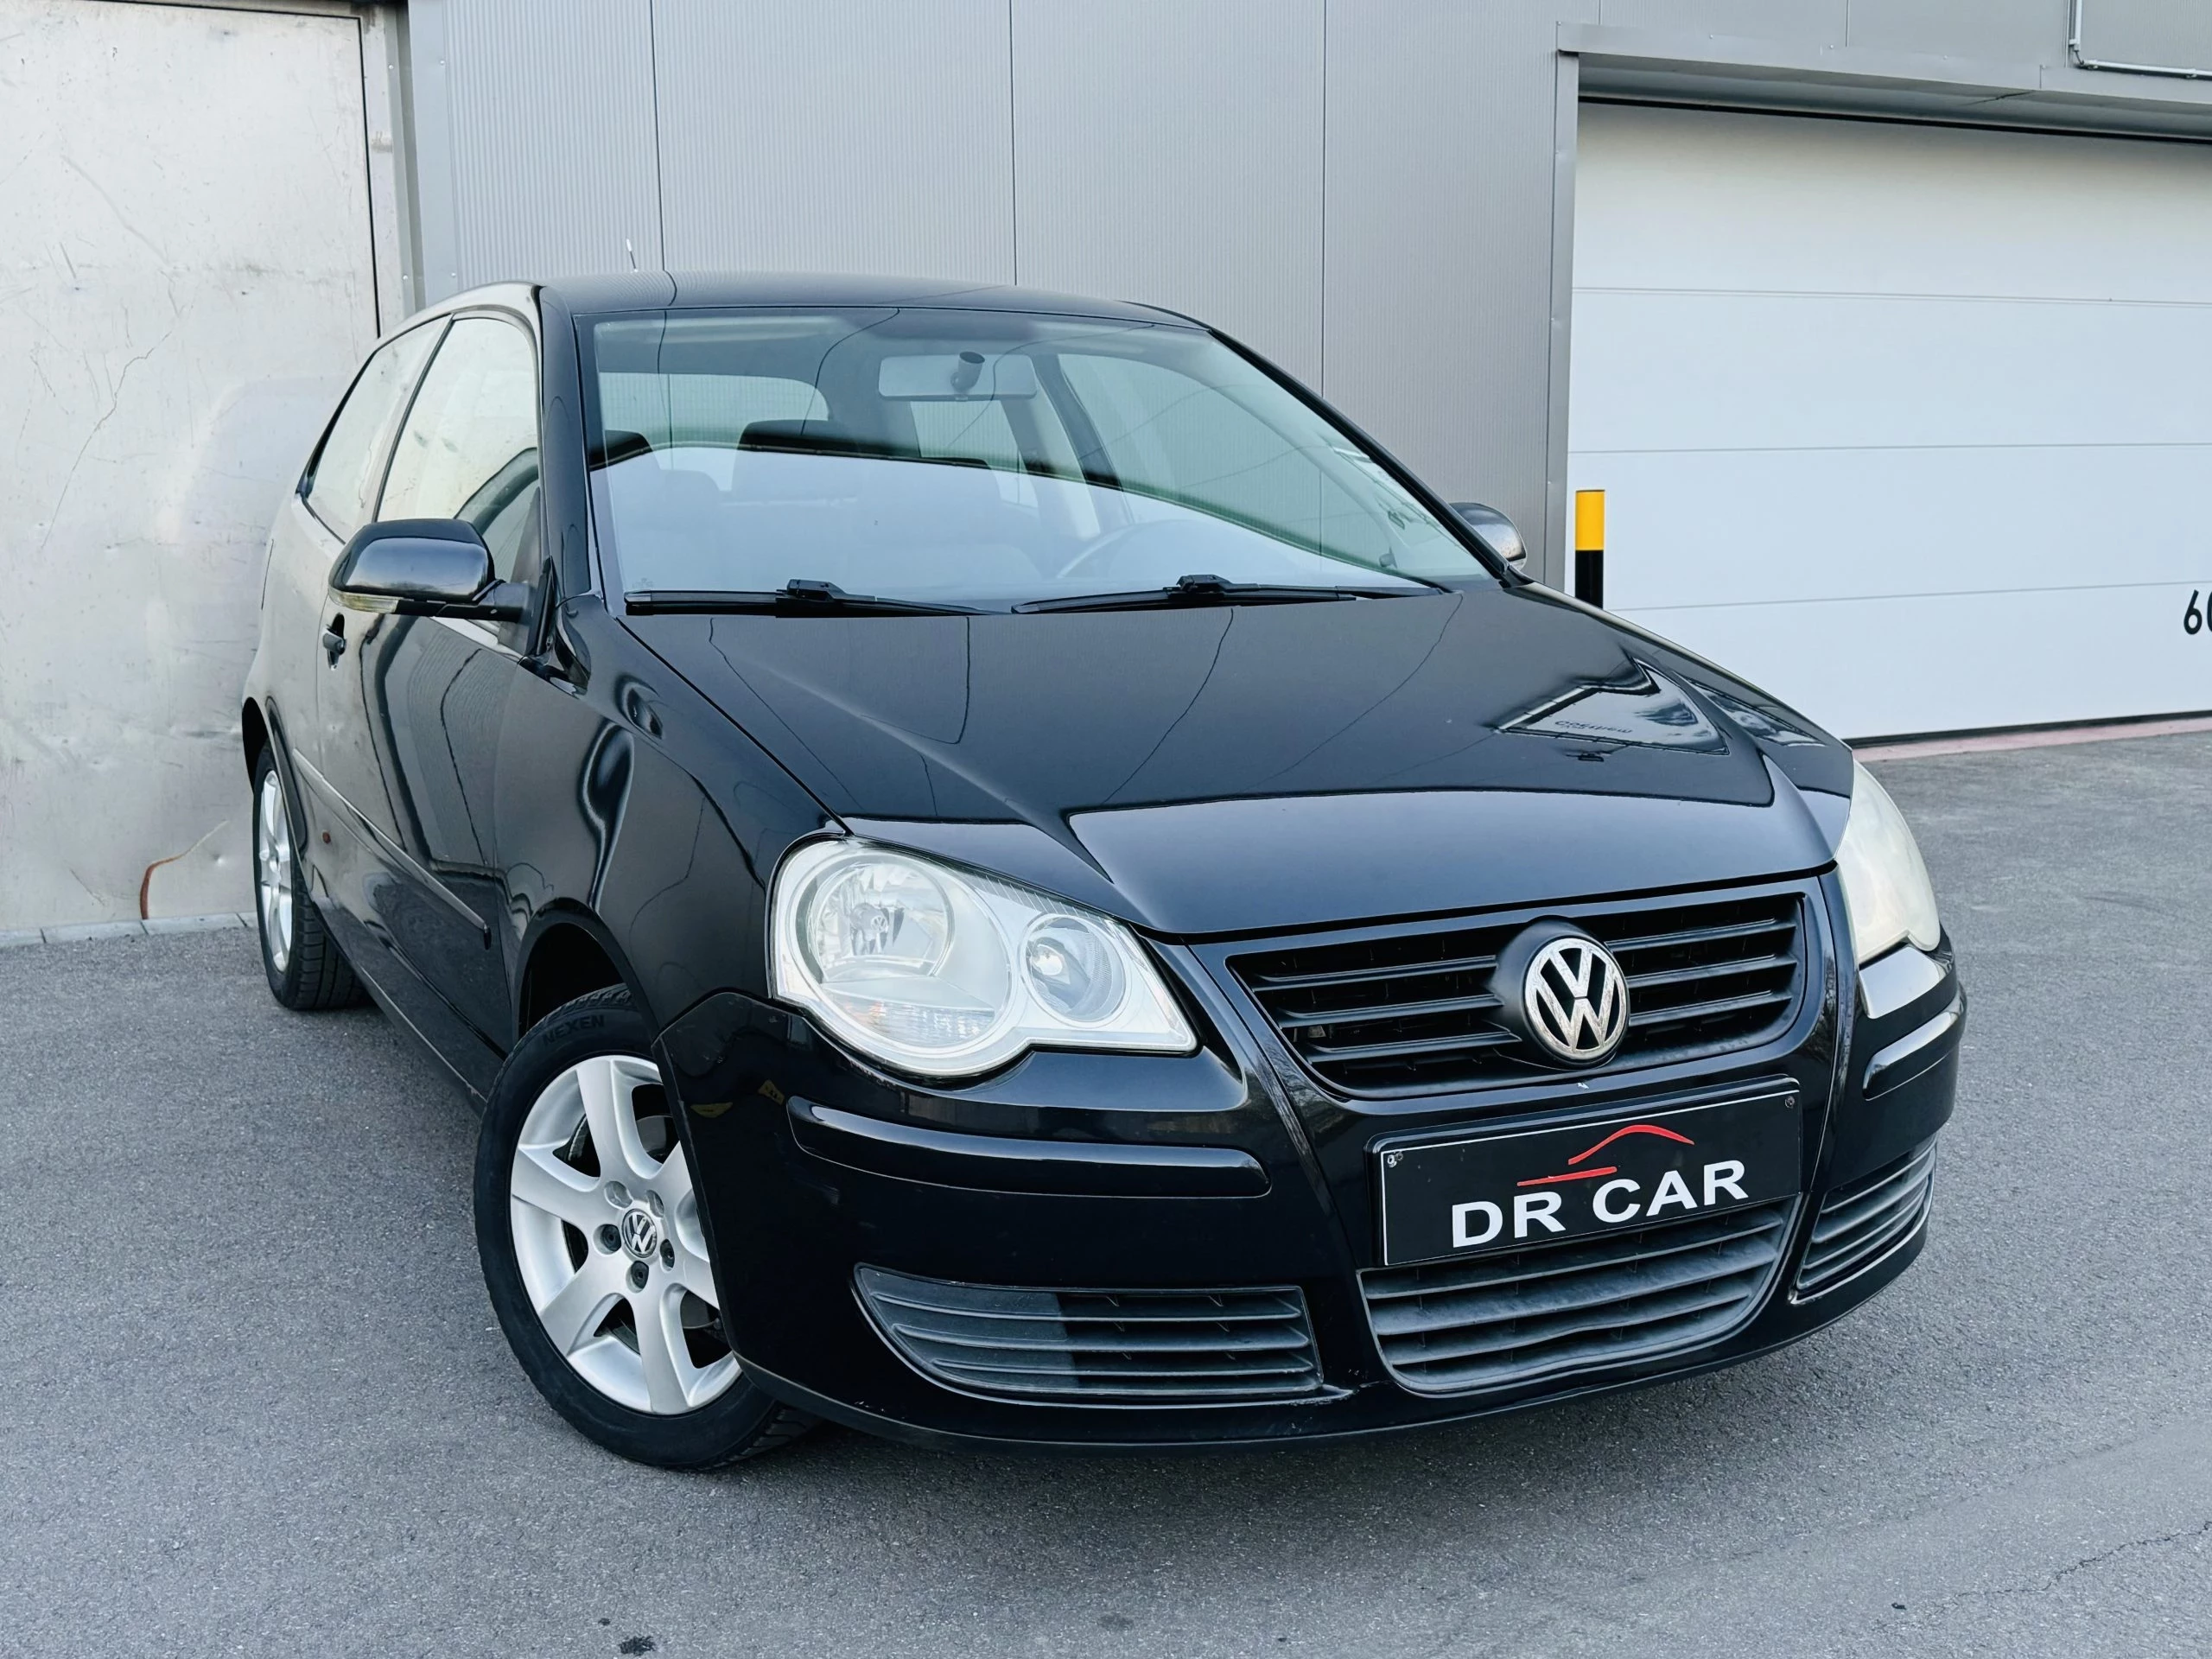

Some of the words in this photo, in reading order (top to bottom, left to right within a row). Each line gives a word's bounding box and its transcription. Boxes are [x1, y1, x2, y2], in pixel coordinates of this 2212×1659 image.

[543, 1014, 604, 1045] NEXEN
[1527, 941, 1624, 1057] VW
[625, 1211, 656, 1255] VW
[1452, 1192, 1567, 1248] DR
[1592, 1160, 1749, 1223] CAR
